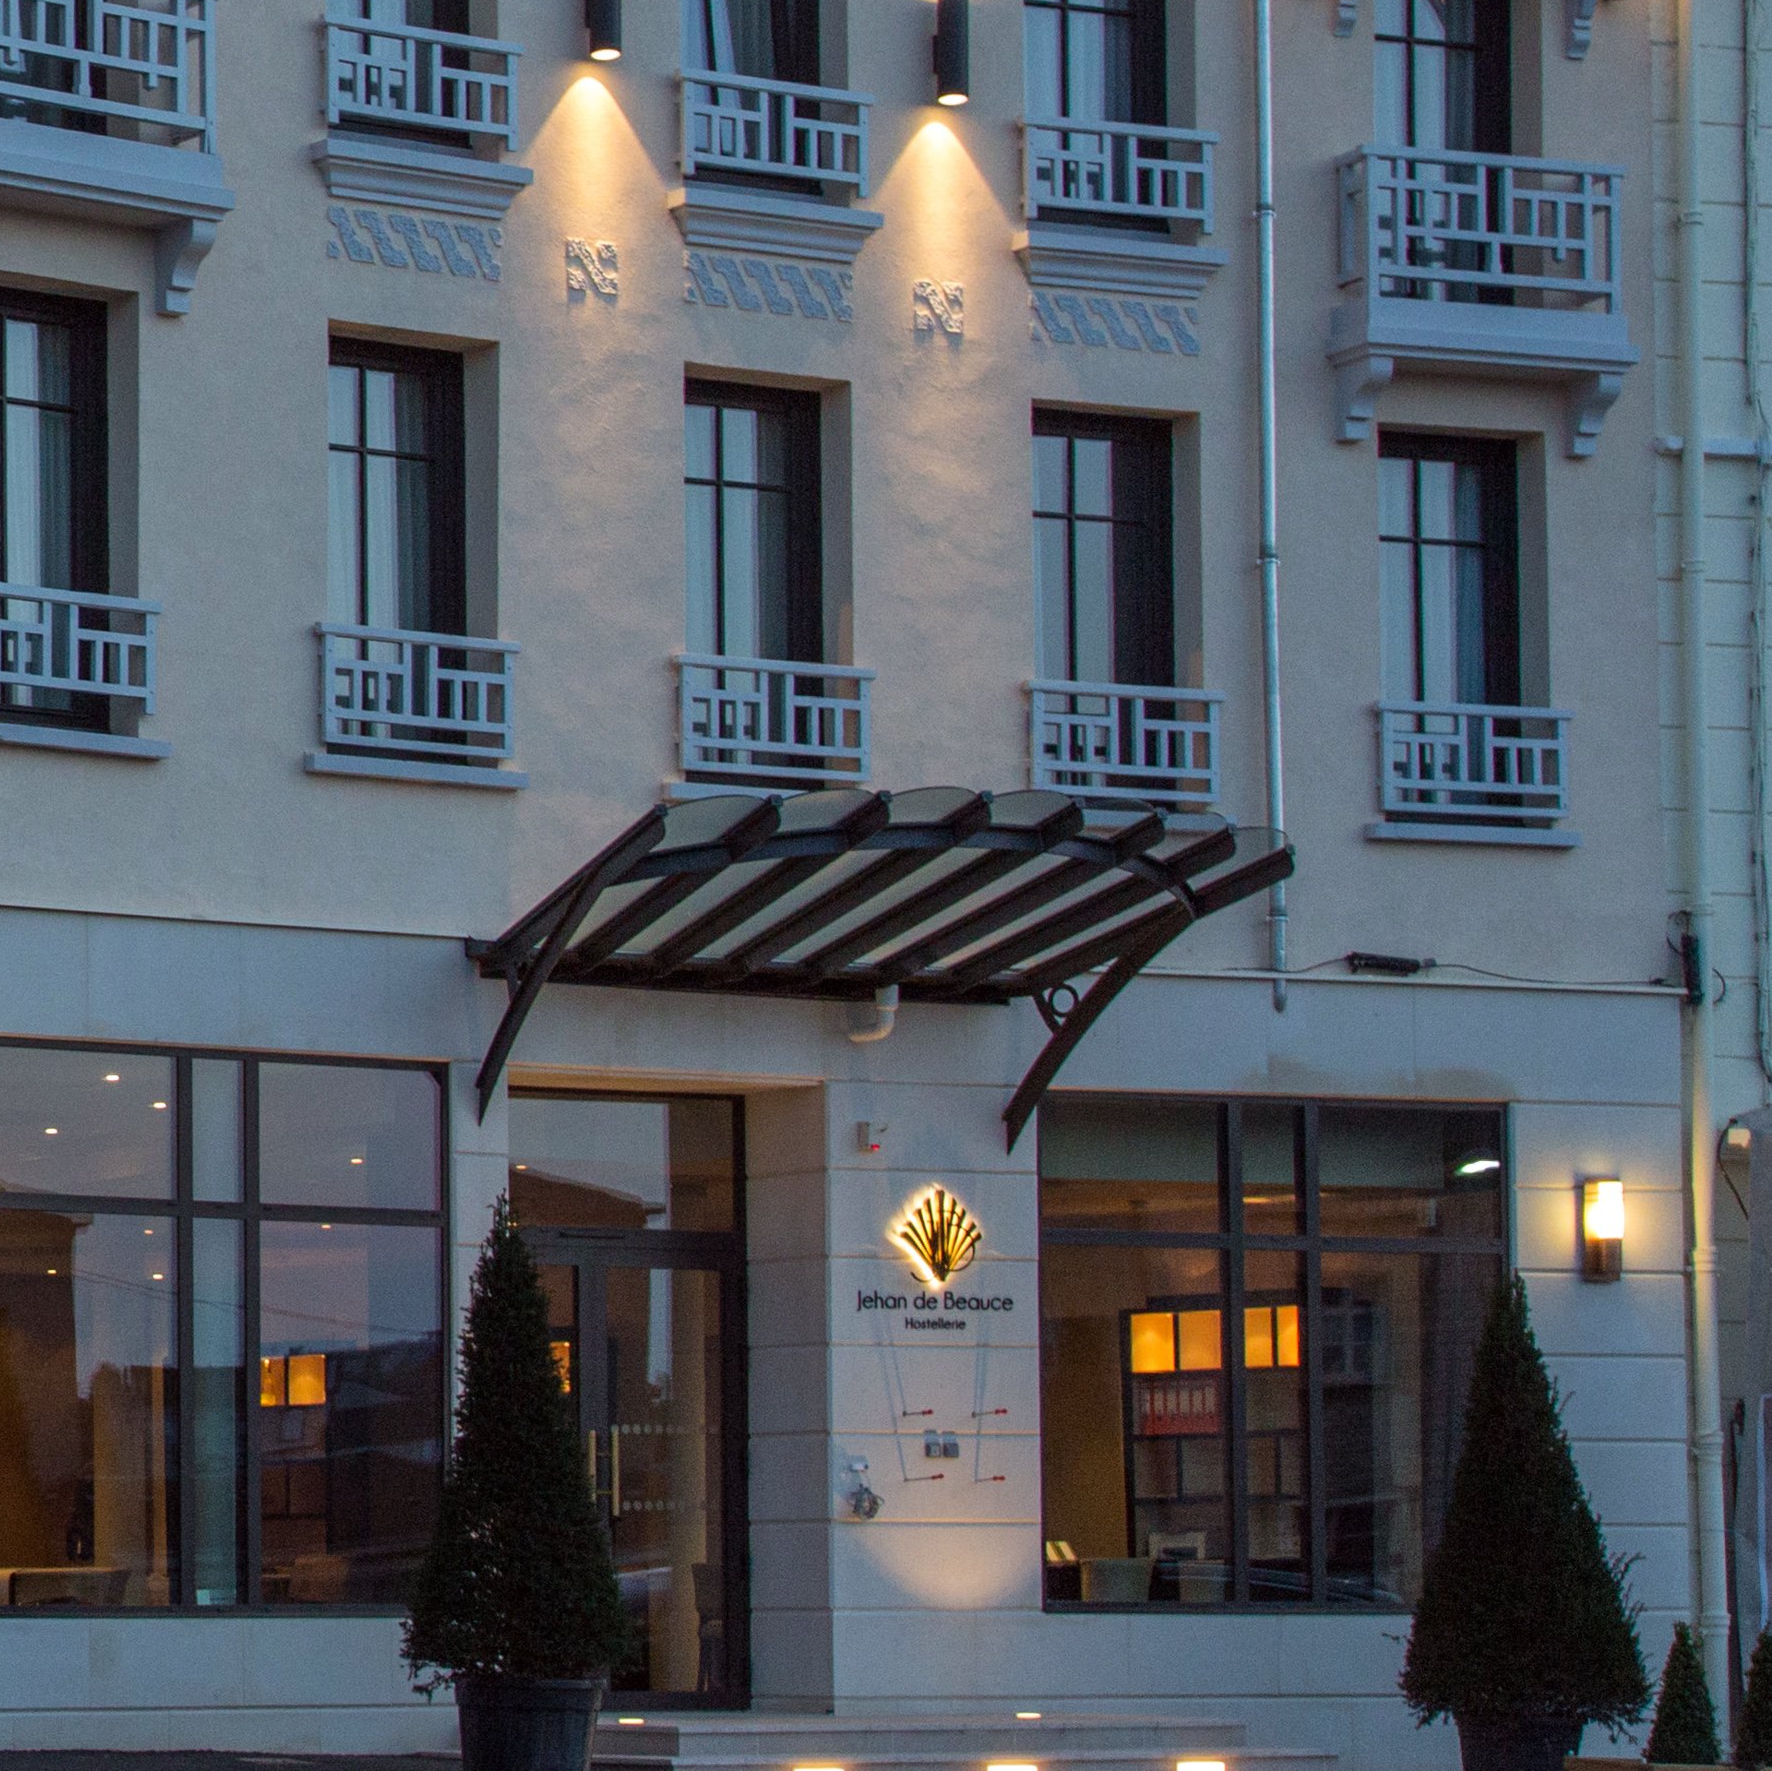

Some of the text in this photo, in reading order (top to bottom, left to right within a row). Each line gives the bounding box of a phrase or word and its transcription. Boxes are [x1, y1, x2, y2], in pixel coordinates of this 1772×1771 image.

[857, 1290, 1014, 1312] Jehan de Beauce
[905, 1317, 966, 1331] Hostellerie
